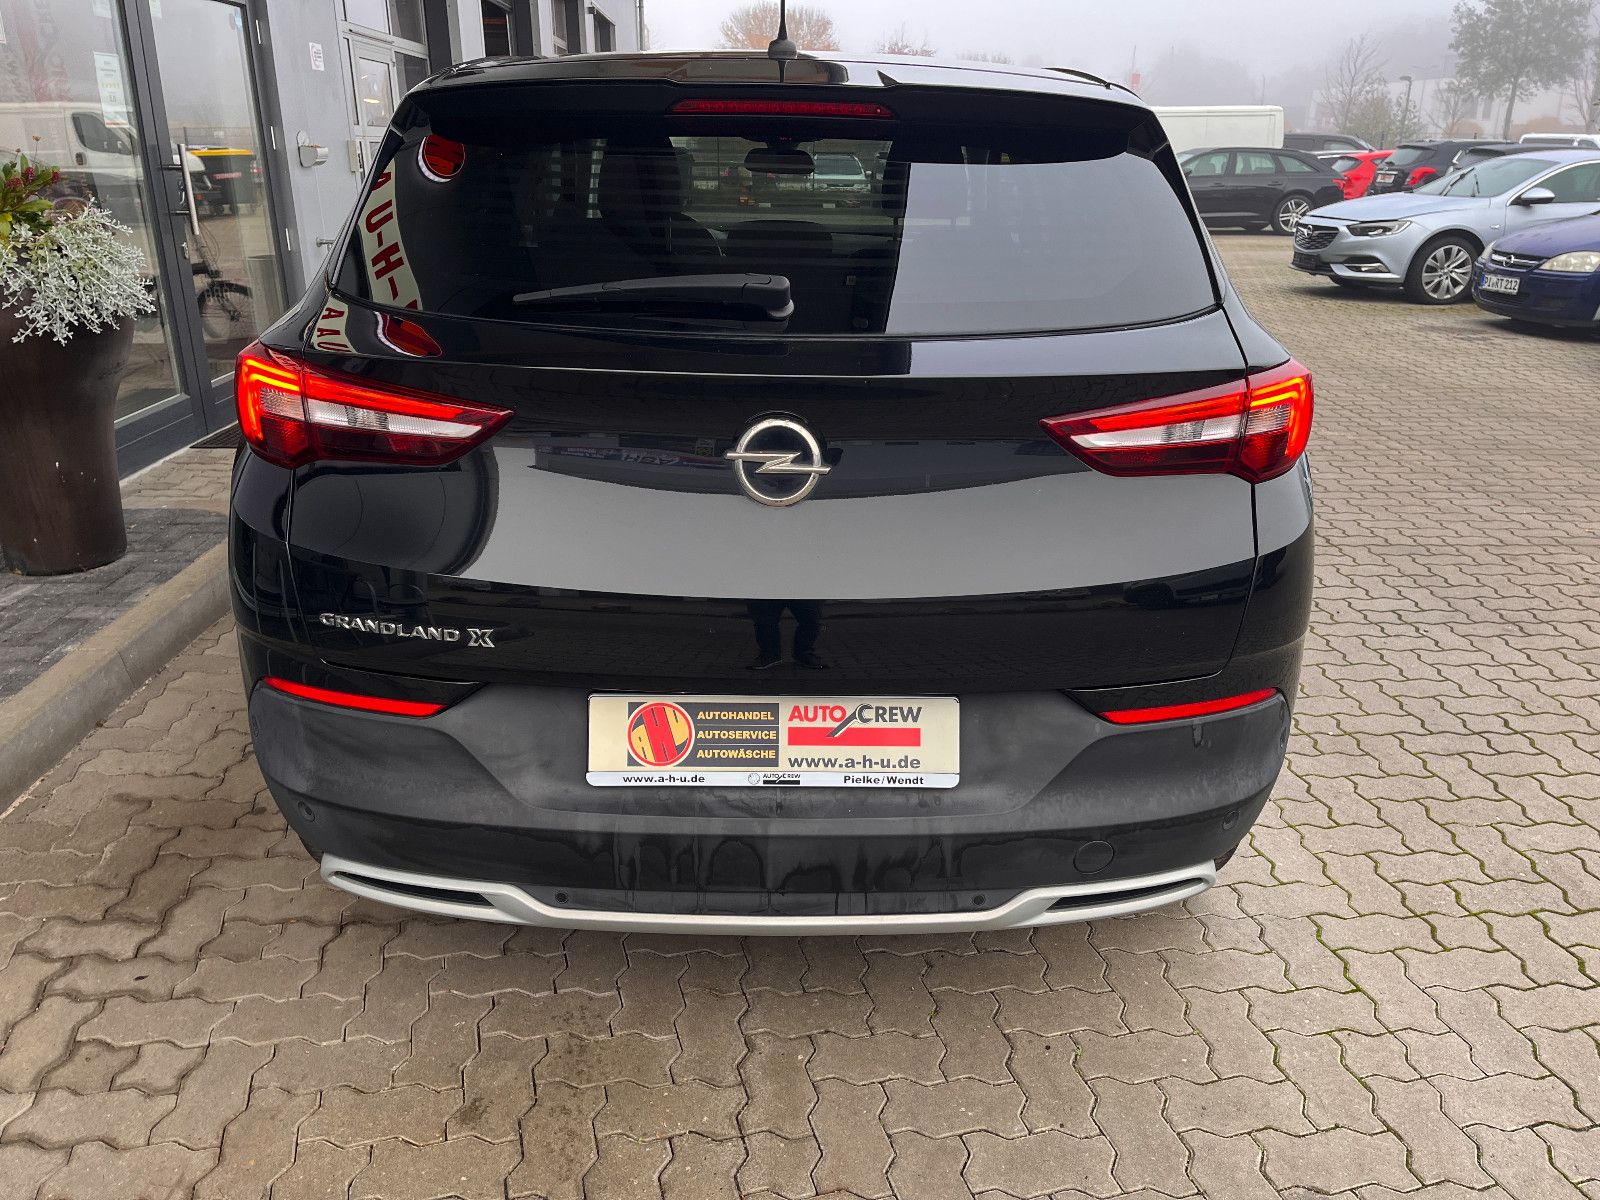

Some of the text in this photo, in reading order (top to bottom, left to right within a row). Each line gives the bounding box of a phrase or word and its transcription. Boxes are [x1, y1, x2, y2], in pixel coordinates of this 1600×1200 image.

[1504, 280, 1518, 291] 212
[319, 612, 495, 648] GRANDLAND X
[697, 711, 775, 720] AUTOHANDEL
[788, 705, 847, 723] AUTO
[697, 730, 777, 740] AUTOSERVICE
[697, 748, 776, 759] AUTOWÄSCHE
[788, 755, 921, 769] www.a-h-u.de
[622, 774, 706, 783] www.a-h-u.de
